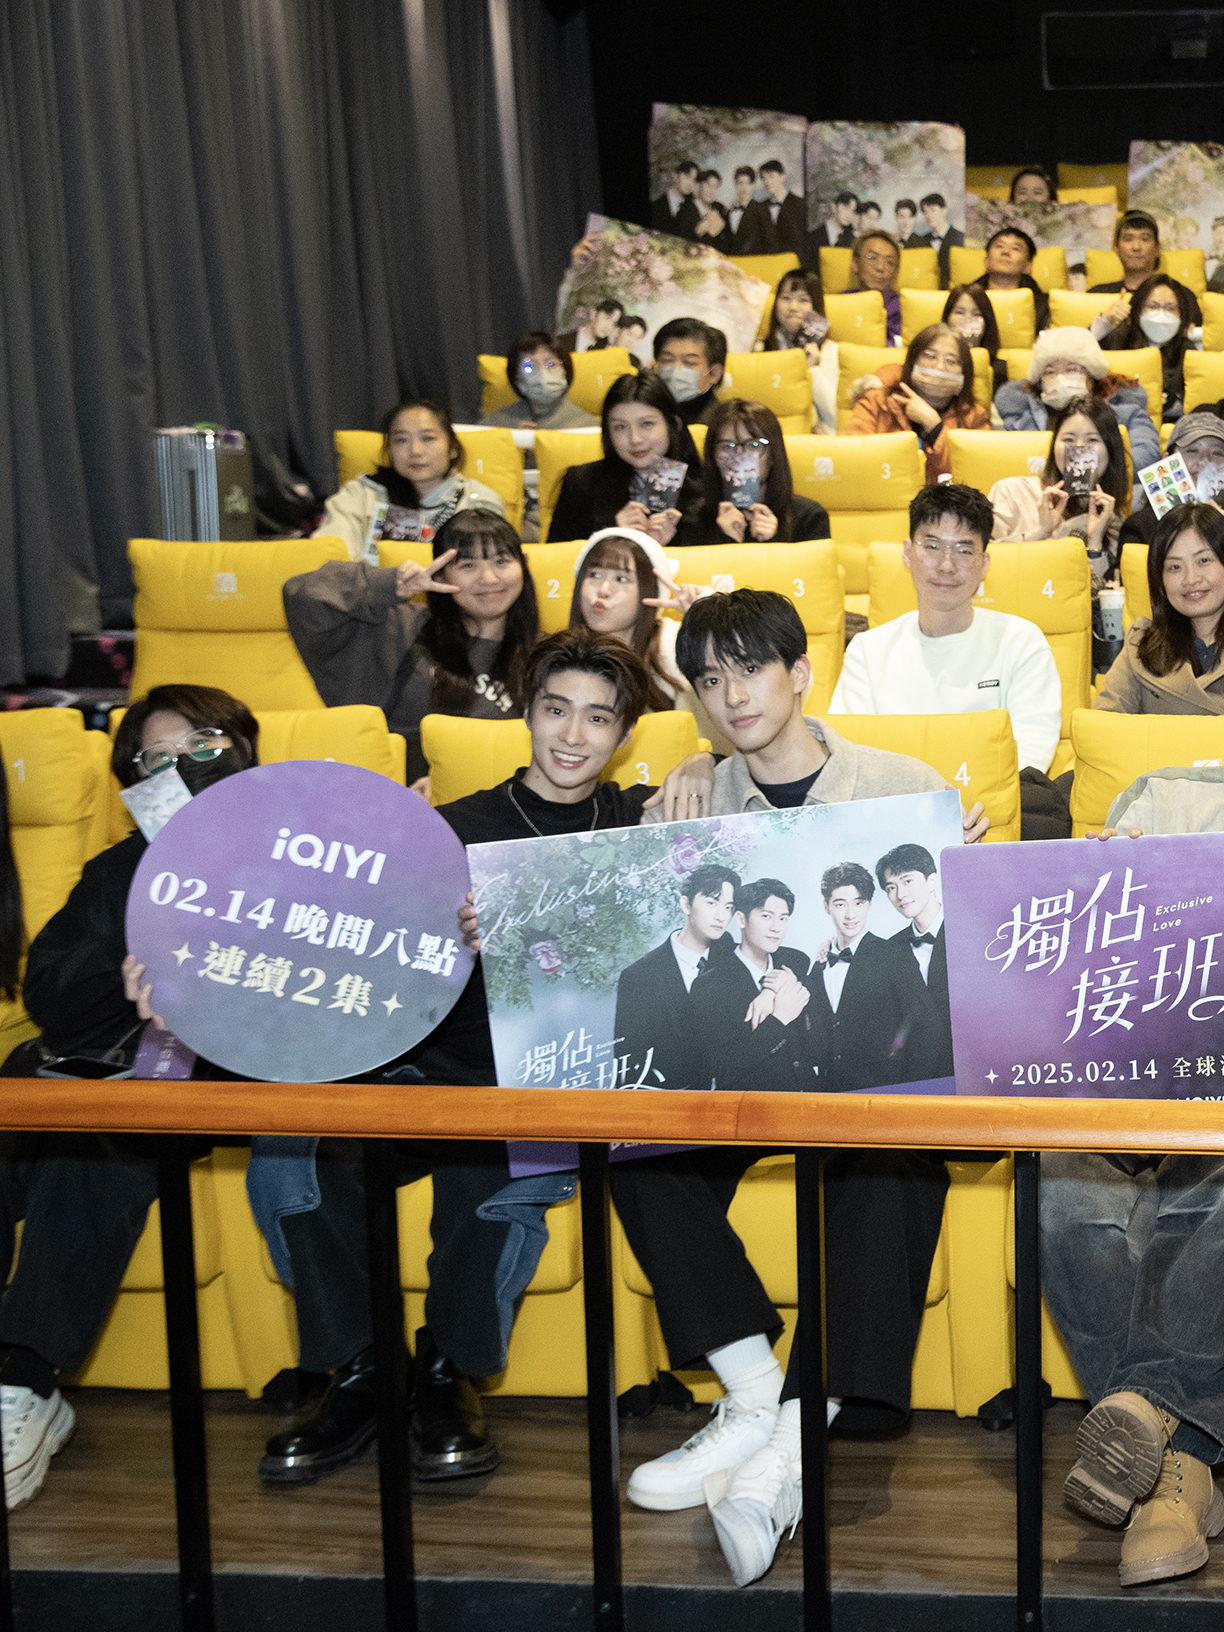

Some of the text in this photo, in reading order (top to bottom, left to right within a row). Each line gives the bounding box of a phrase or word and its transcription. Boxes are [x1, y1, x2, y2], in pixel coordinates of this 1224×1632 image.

[856, 316, 863, 328] 2
[1007, 312, 1014, 325] 3
[773, 374, 781, 388] 2
[477, 459, 483, 474] 1
[881, 463, 891, 480] 3
[547, 579, 560, 598] 2
[792, 578, 805, 597] 3
[1041, 579, 1055, 599] 4
[13, 758, 25, 782] 1
[636, 762, 650, 785] 3
[953, 762, 971, 786] 4
[270, 827, 387, 886] iQIYI
[1155, 893, 1213, 916] Exclusive
[148, 870, 459, 979] 02.14 晚間八點
[984, 866, 1148, 976] 獨佔
[1152, 917, 1182, 932] Love
[197, 939, 375, 1018] 連續2集
[513, 1027, 593, 1086] 獨佔
[1010, 1058, 1159, 1086] 2025.02.14
